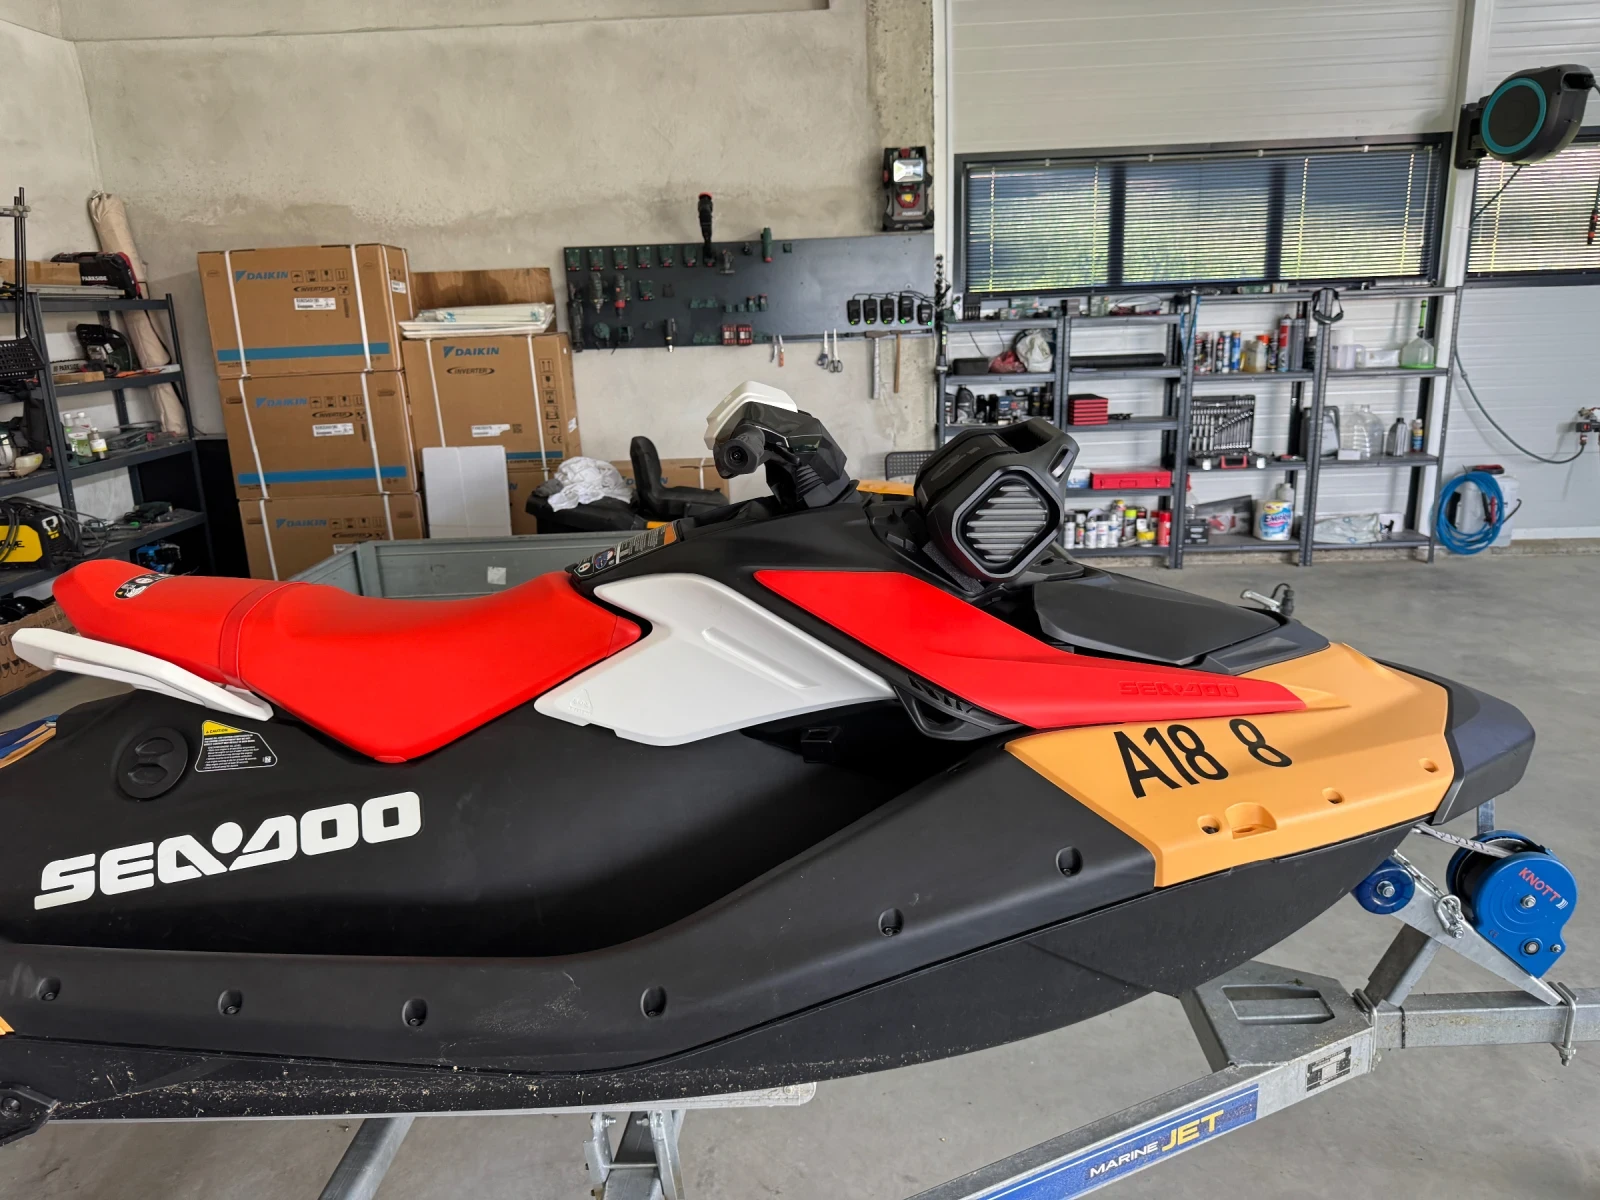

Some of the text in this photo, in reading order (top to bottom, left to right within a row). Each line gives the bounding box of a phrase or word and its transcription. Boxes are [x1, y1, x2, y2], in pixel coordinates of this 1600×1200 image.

[246, 270, 289, 280] DAIKIN
[455, 347, 499, 356] DAIKIN
[267, 398, 307, 407] DAIKIN
[286, 519, 327, 528] DAIKIN
[1113, 718, 1293, 799] A18 8
[1518, 867, 1561, 903] KNOTT
[1090, 1140, 1159, 1178] MARINE
[1161, 1109, 1224, 1152] JET
